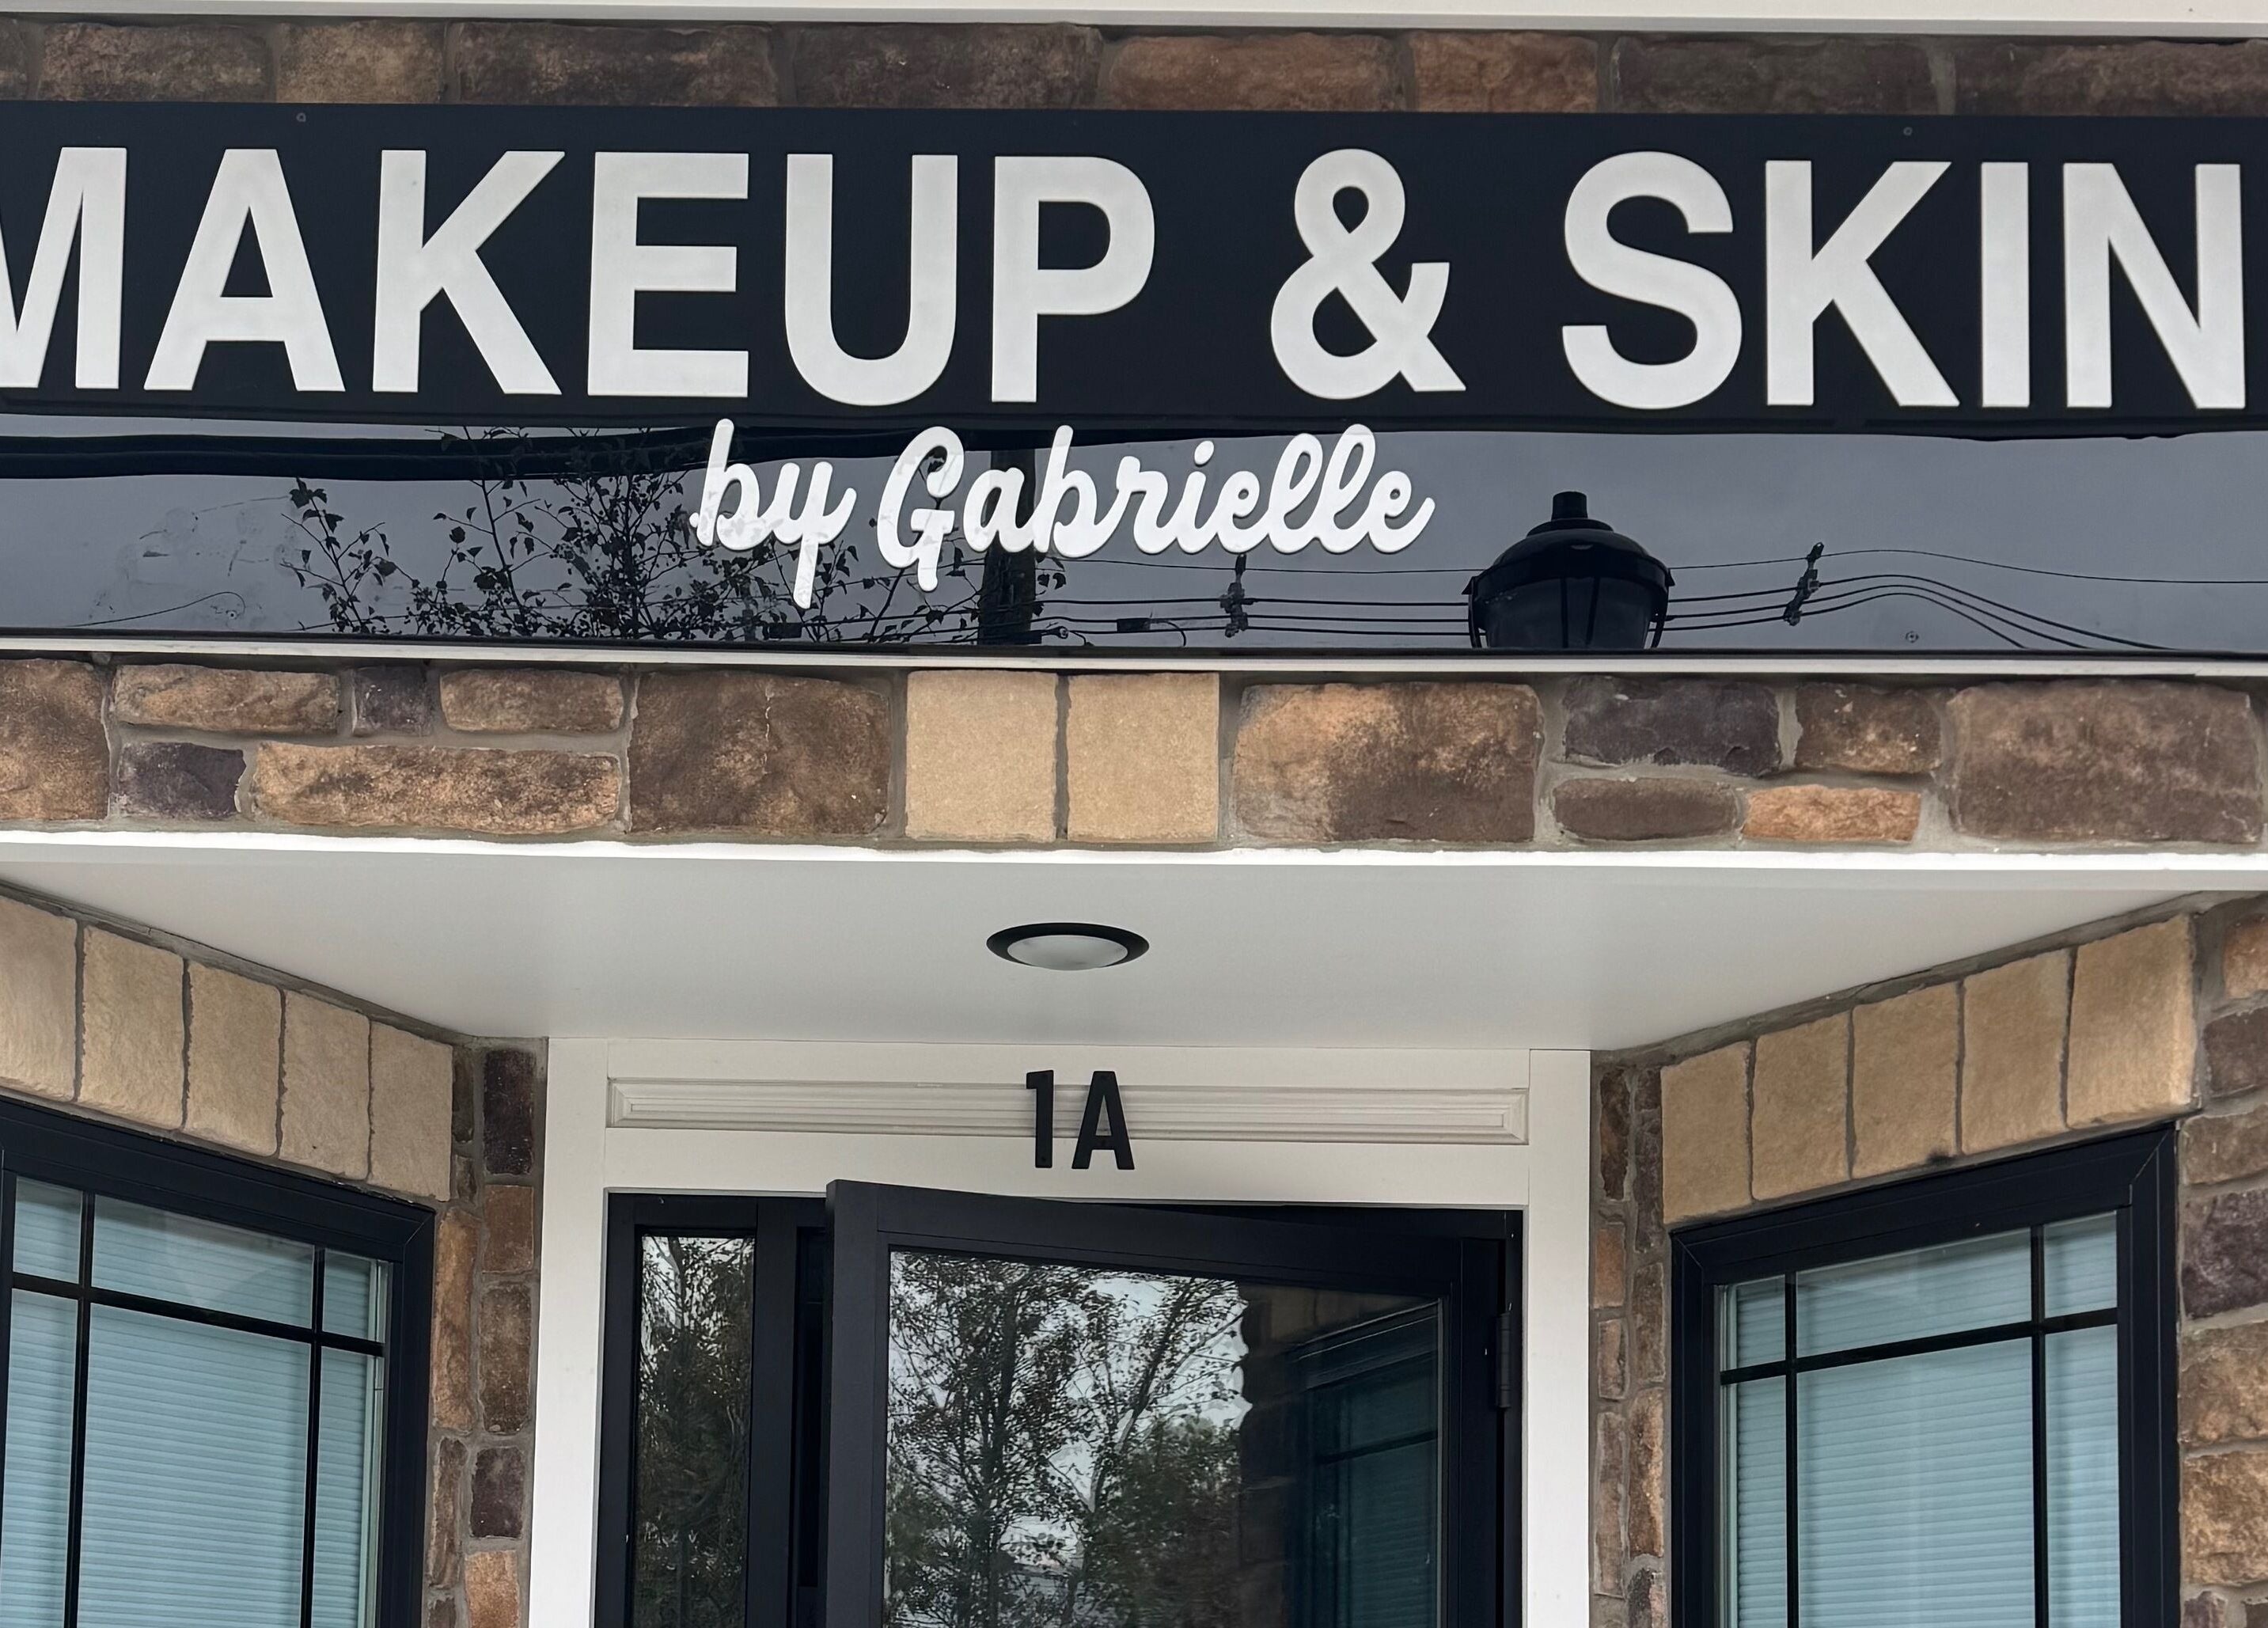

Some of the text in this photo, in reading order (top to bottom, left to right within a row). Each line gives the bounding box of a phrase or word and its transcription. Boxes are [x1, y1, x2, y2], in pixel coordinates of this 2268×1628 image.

[0, 147, 2244, 408] MAKEUP & SKIN
[689, 419, 1435, 609] by Gabrielle
[1025, 1070, 1136, 1170] 1A
